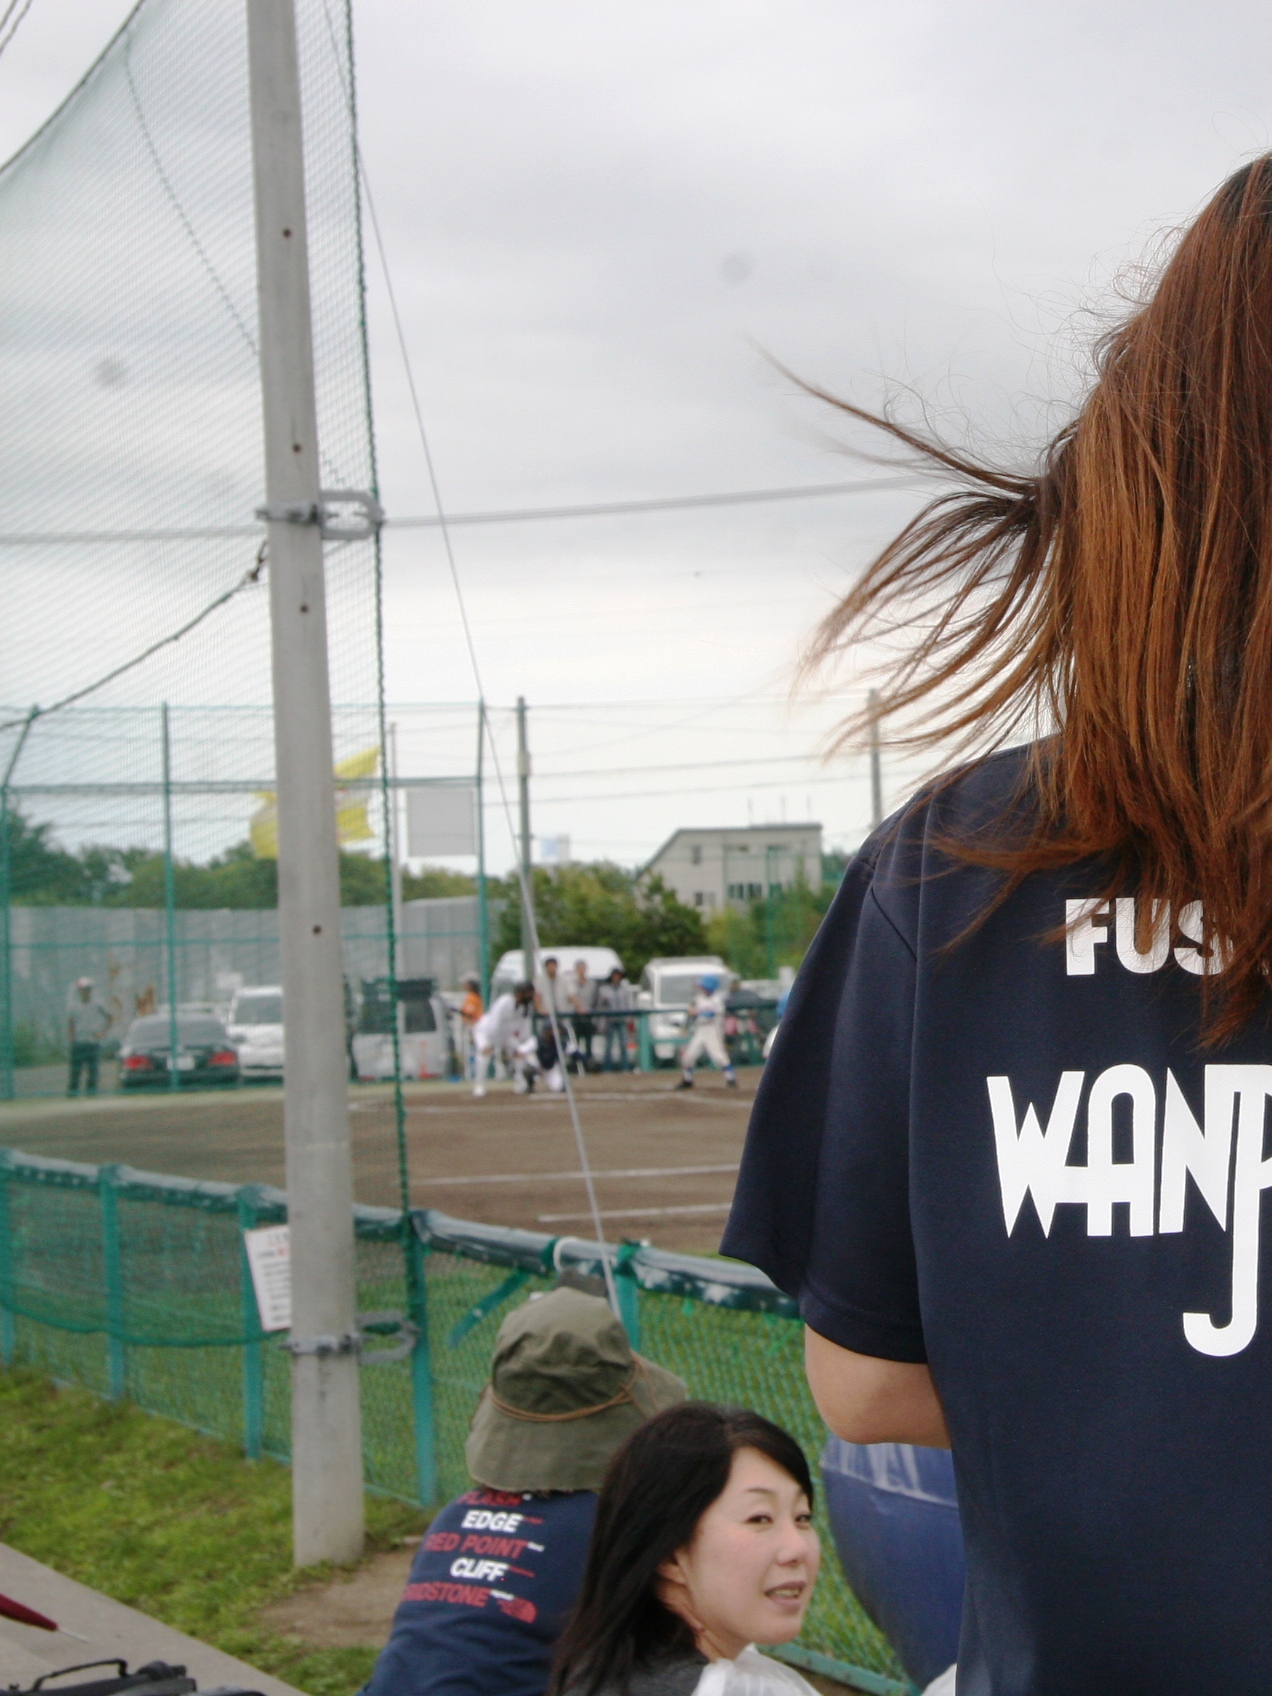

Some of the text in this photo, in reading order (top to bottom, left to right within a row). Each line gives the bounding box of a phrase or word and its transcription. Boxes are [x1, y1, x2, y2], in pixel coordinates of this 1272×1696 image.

[462, 1510, 523, 1532] EDGE
[462, 1535, 529, 1558] POINT
[451, 1557, 509, 1581] CLIFF
